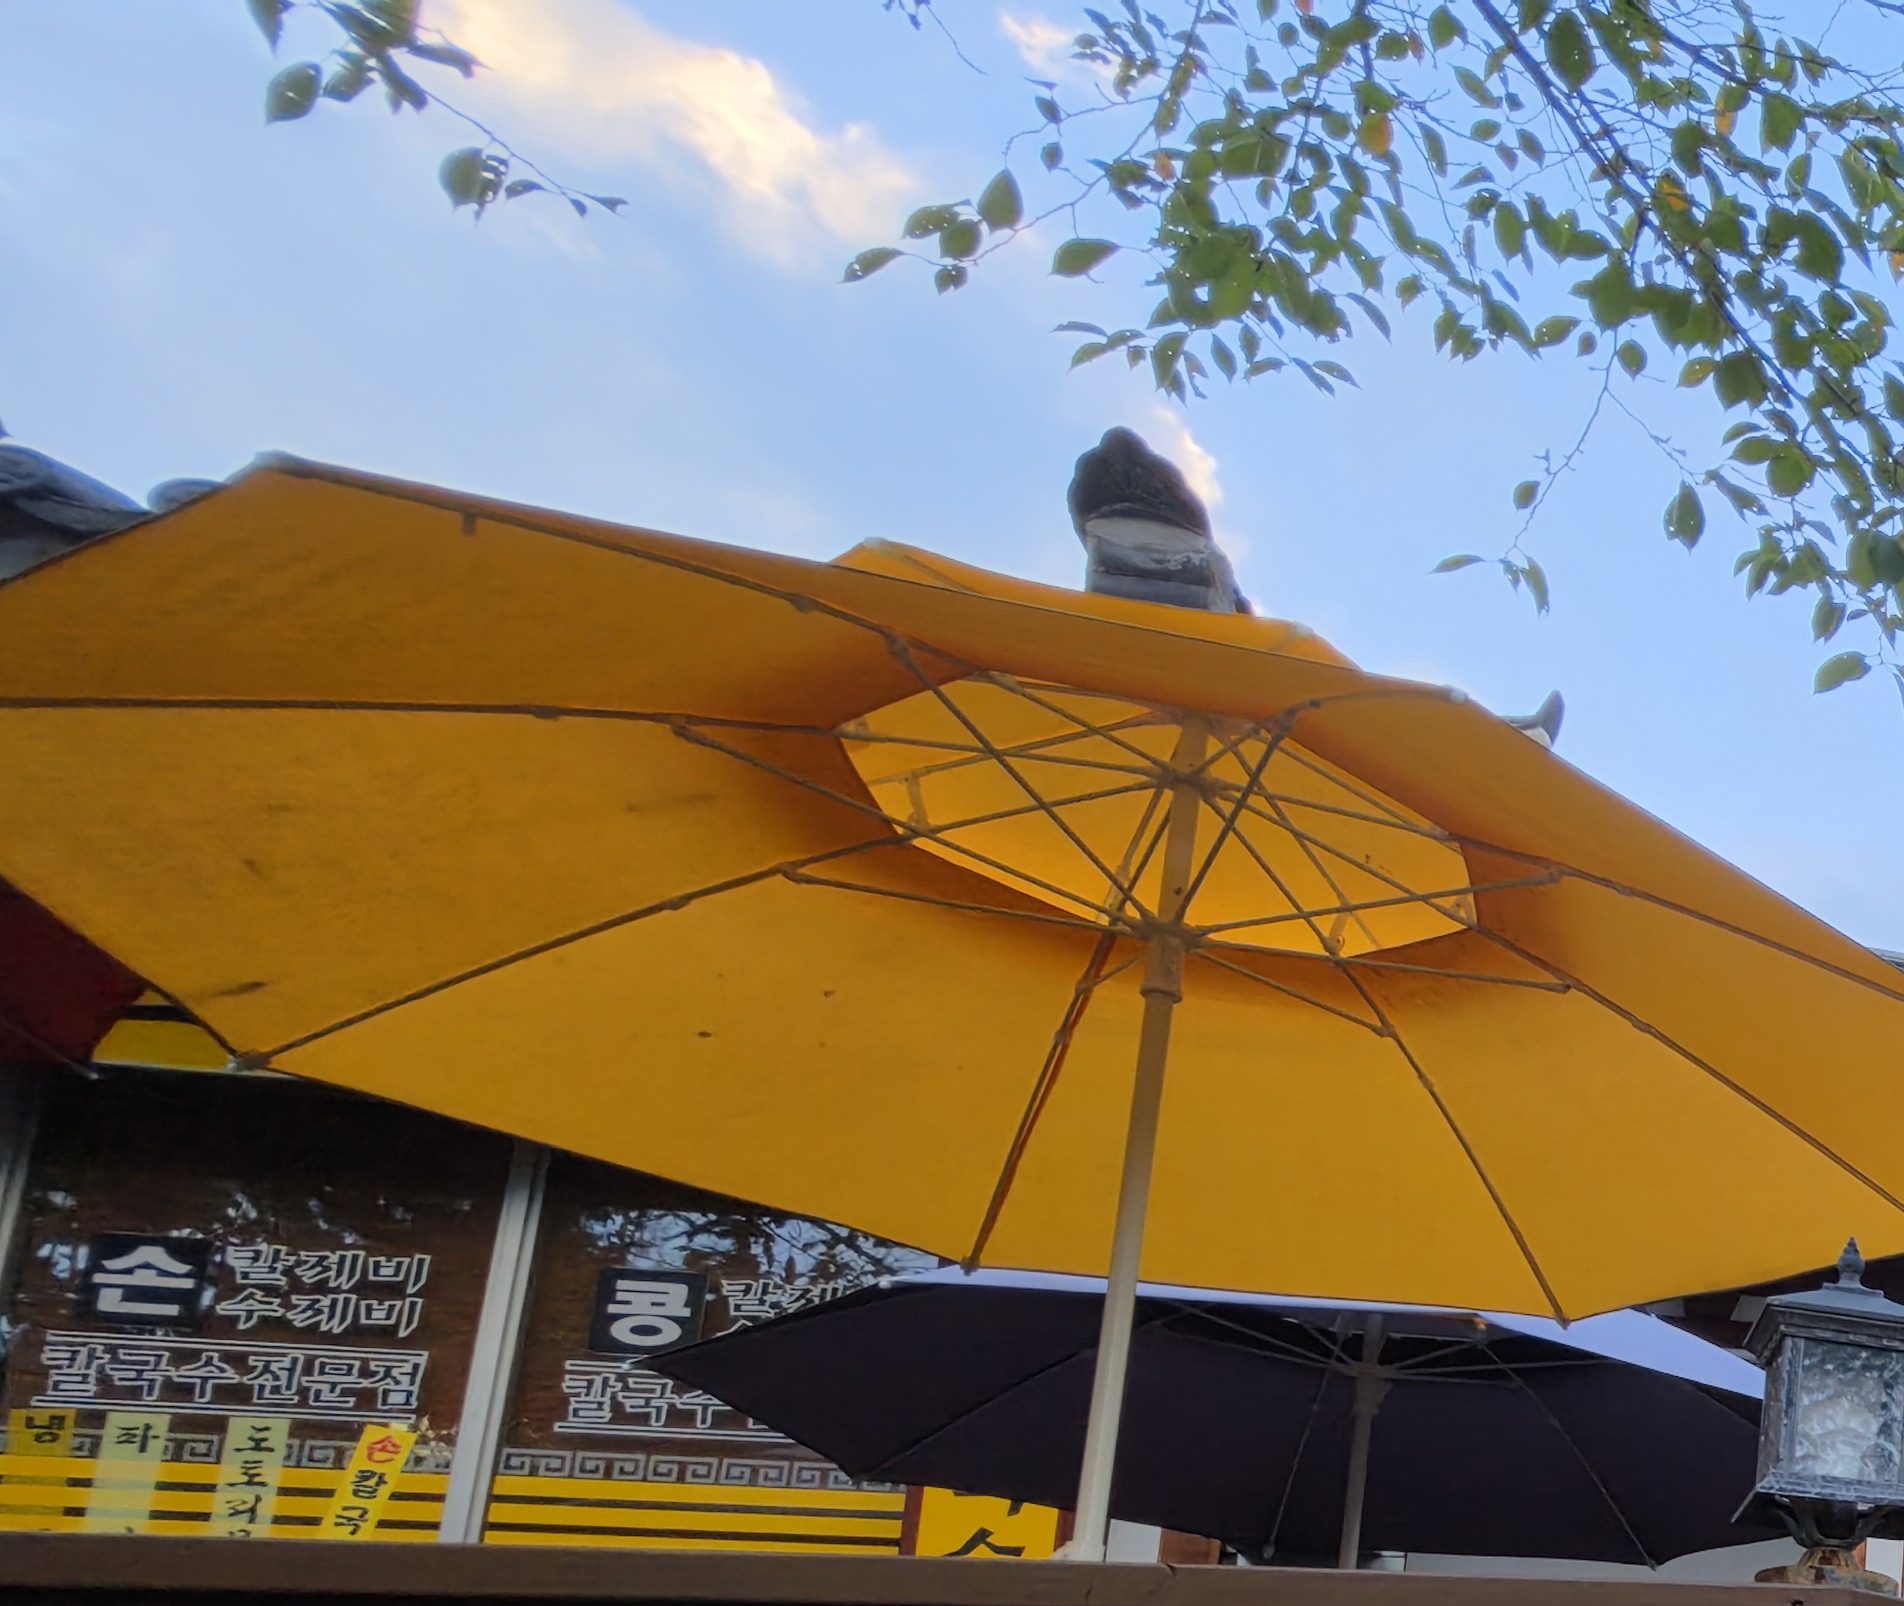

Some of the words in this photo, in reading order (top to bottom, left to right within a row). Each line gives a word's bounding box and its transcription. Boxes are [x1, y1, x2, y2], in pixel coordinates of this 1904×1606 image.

[92, 1245, 196, 1317] 손
[216, 1288, 424, 1337] 수제비
[607, 1280, 691, 1347] 콩
